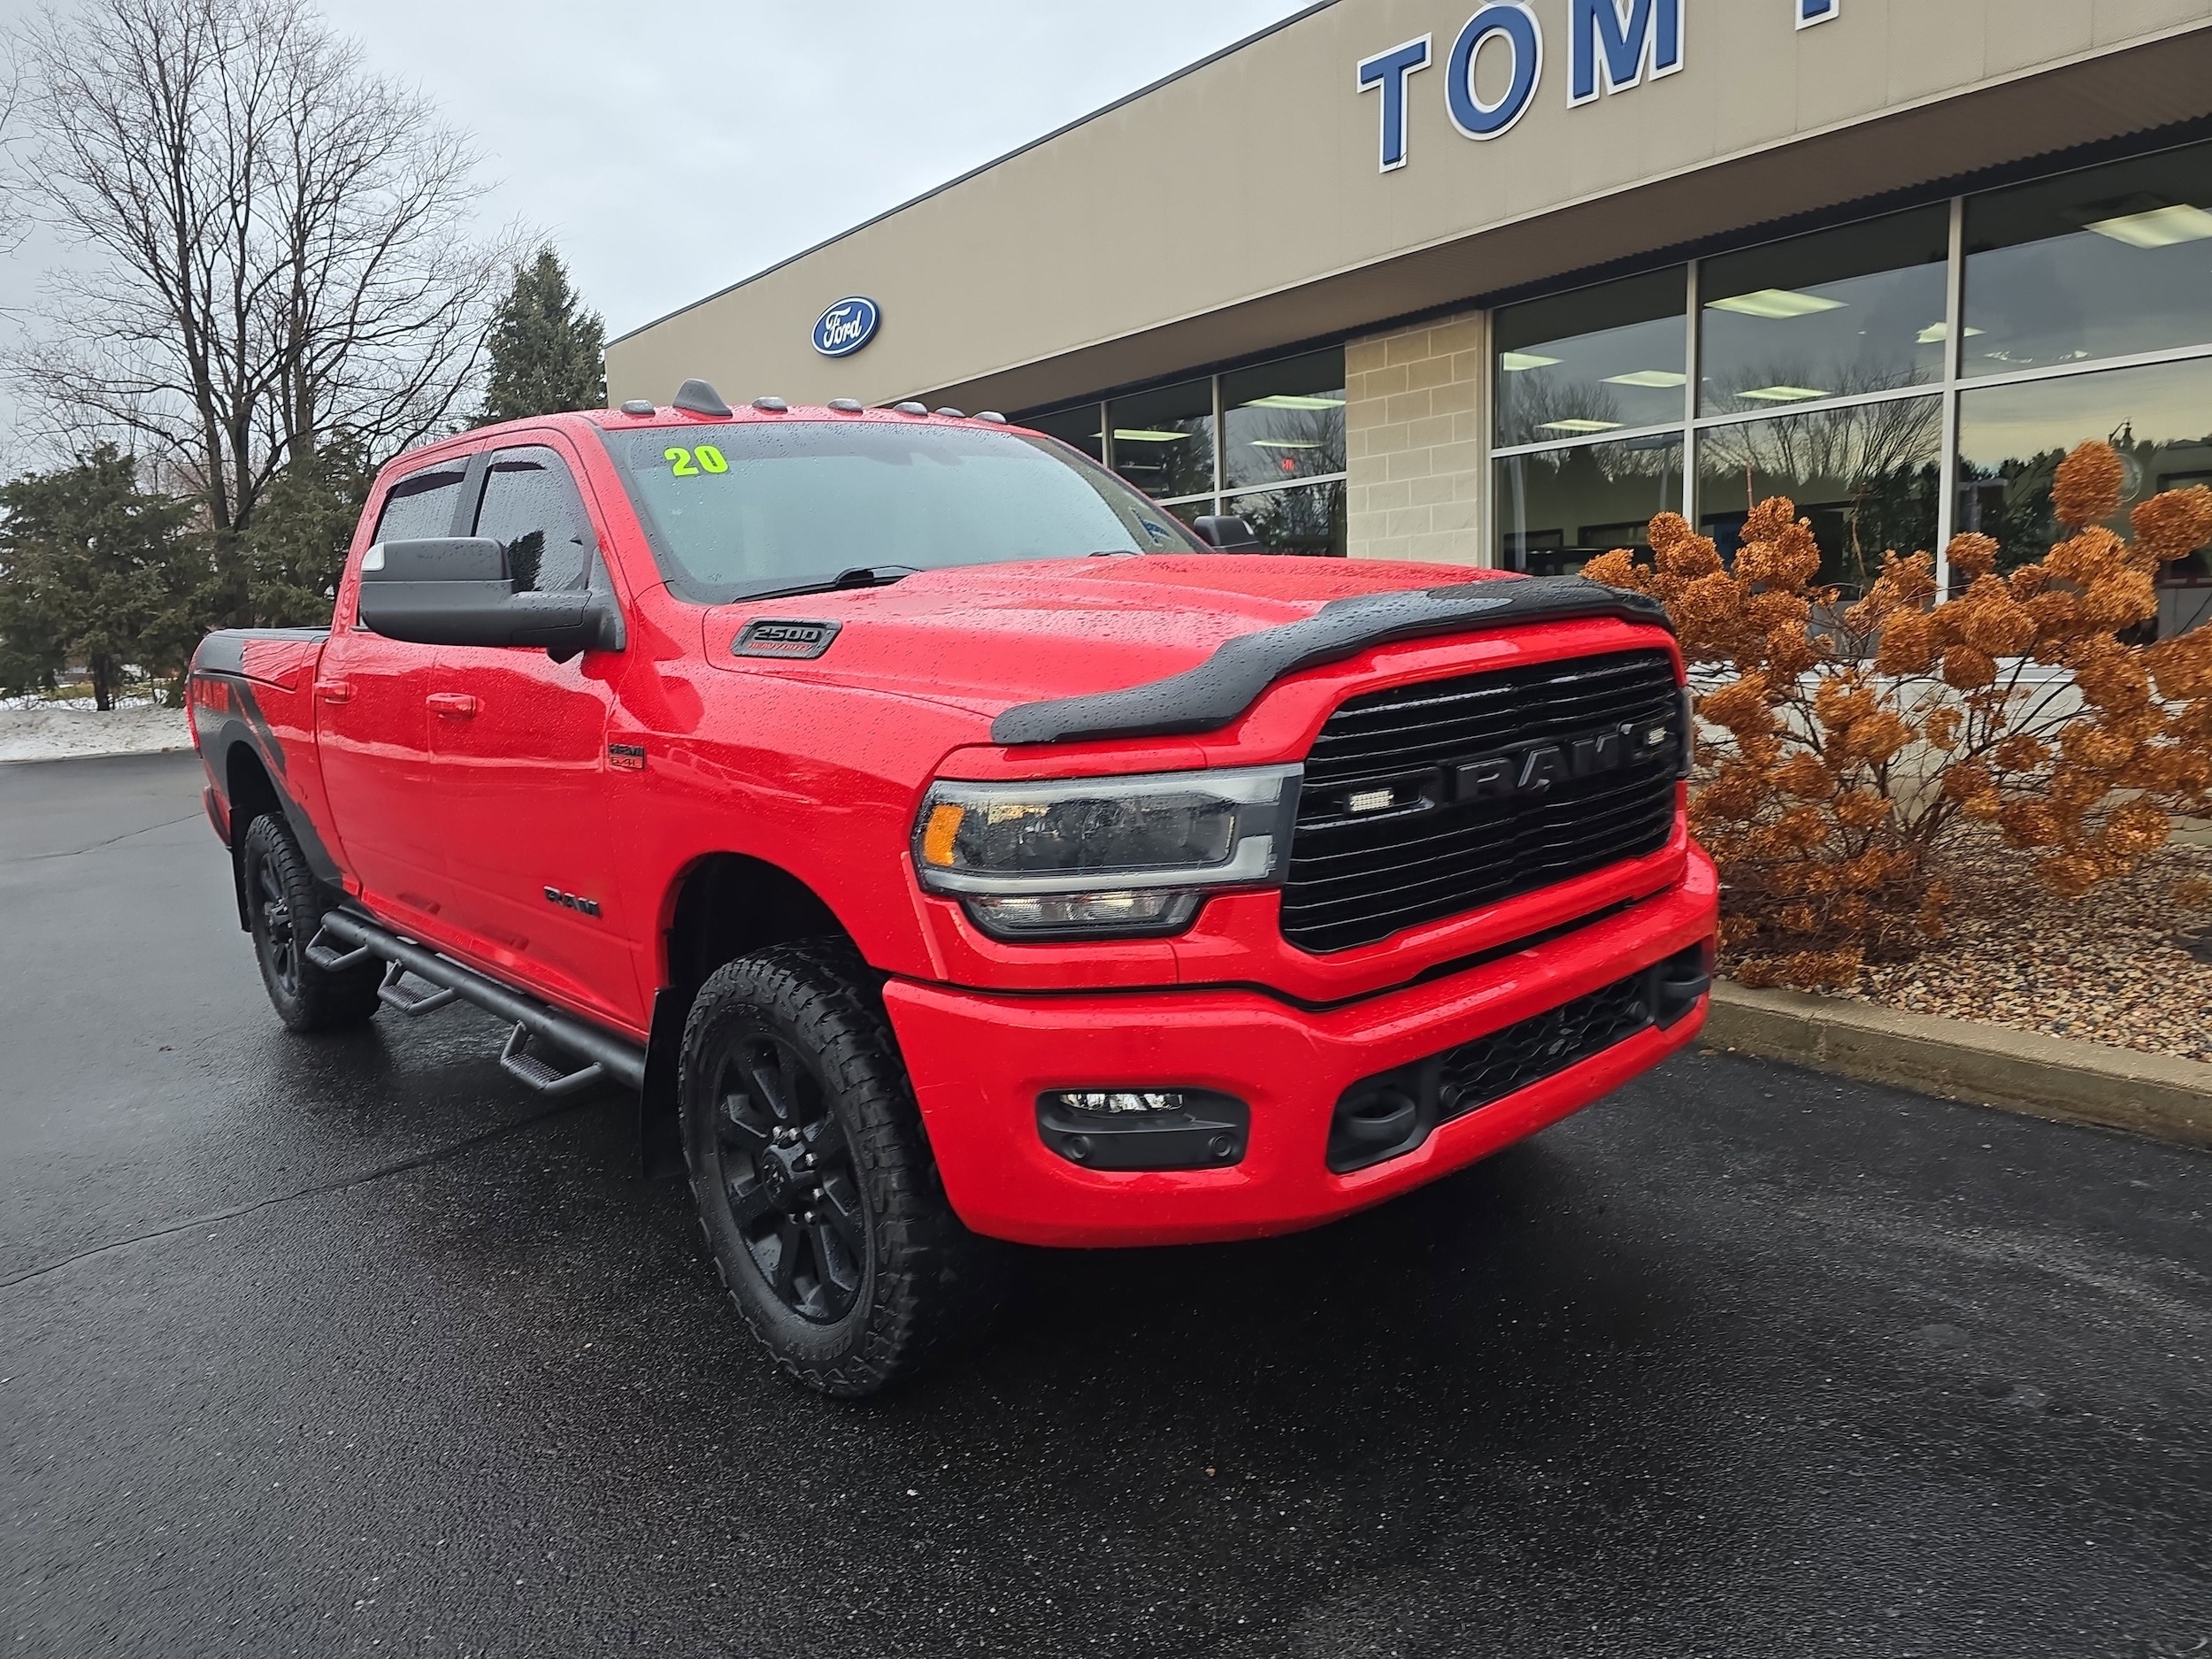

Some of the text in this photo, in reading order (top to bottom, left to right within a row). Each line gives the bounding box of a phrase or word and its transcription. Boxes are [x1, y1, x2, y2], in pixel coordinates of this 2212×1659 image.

[1356, 0, 1685, 173] TOM
[823, 305, 863, 348] Ford
[664, 445, 729, 476] 20
[754, 627, 820, 643] 2500
[1455, 733, 1621, 802] RAM
[543, 886, 601, 918] RAM
